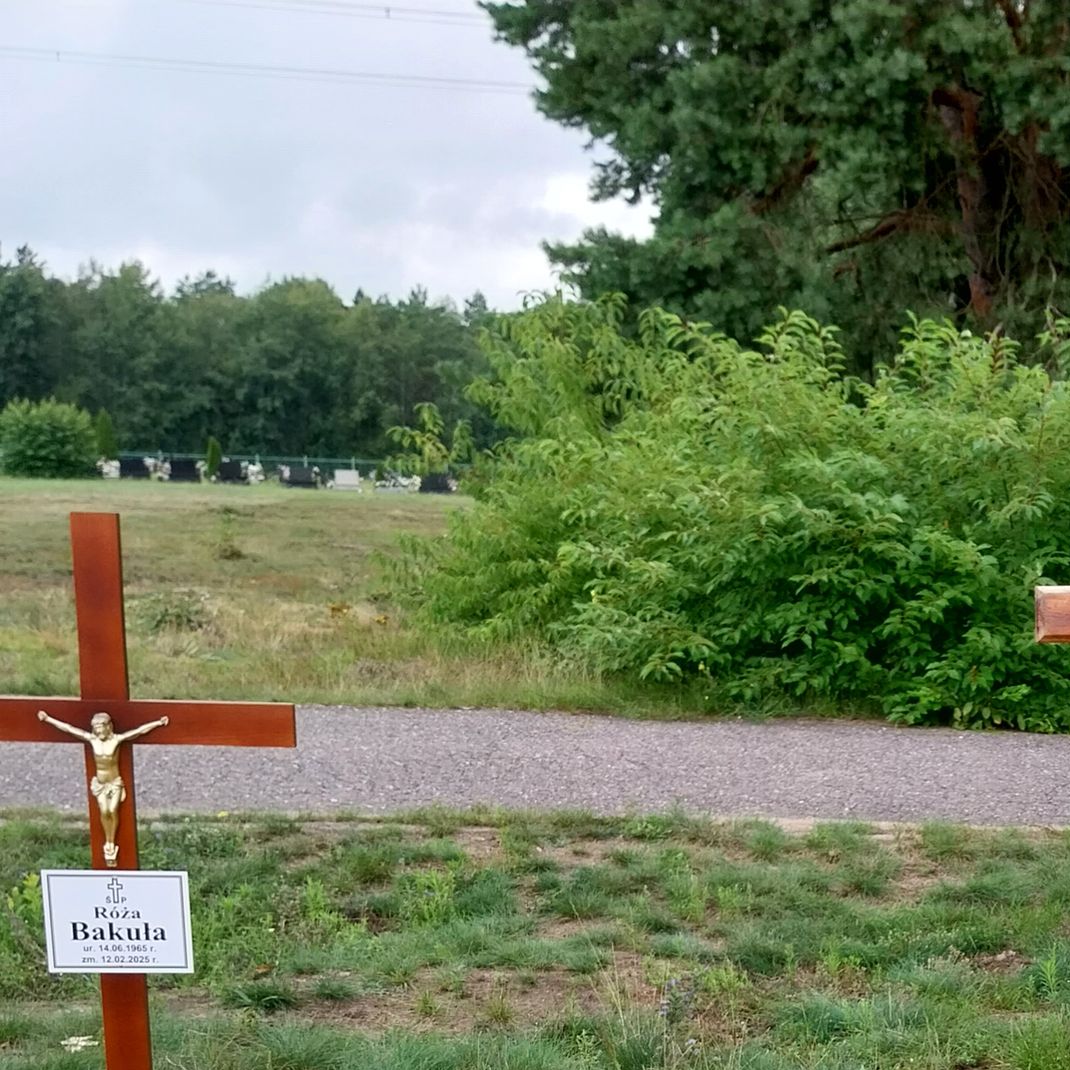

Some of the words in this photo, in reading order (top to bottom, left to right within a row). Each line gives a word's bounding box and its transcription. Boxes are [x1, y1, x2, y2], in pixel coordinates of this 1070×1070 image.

[121, 896, 127, 904] P
[94, 906, 141, 919] Róża
[71, 921, 167, 941] Bakuła
[99, 944, 148, 952] 14.06.1965
[101, 955, 150, 963] 12.02.2025
